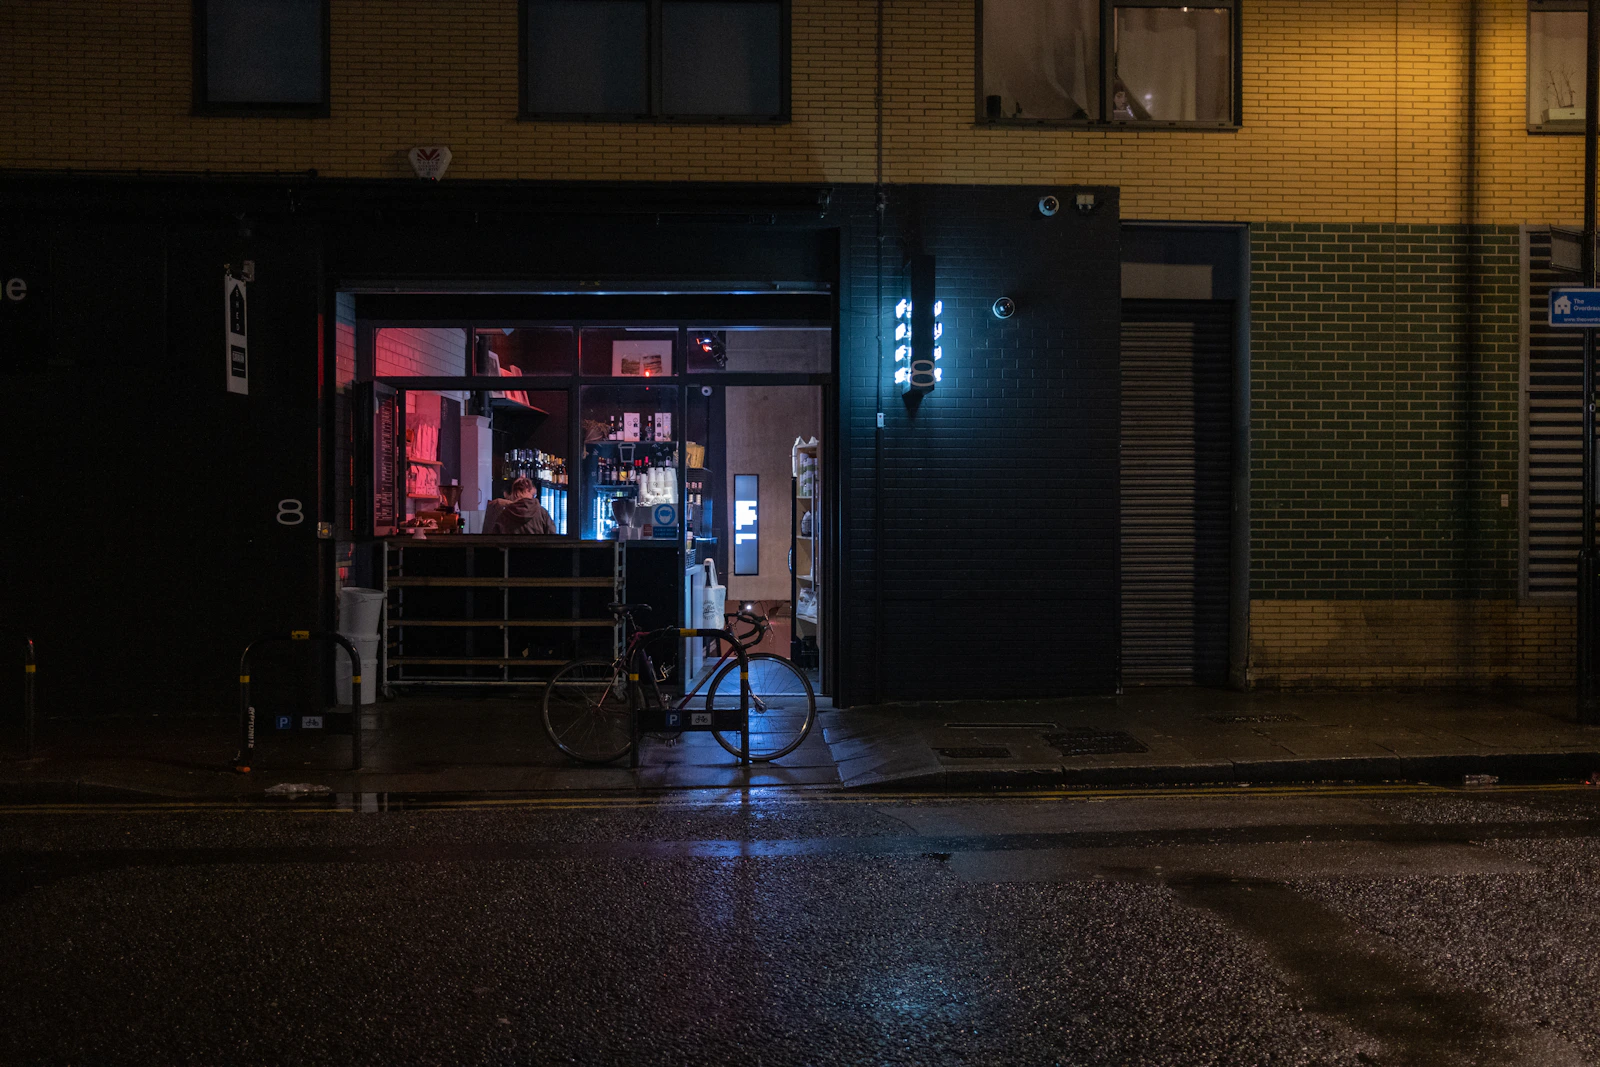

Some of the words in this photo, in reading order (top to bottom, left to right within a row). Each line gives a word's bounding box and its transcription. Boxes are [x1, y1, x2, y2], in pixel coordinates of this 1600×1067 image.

[0, 278, 27, 301] e
[911, 359, 935, 387] 8
[276, 499, 305, 526] 8
